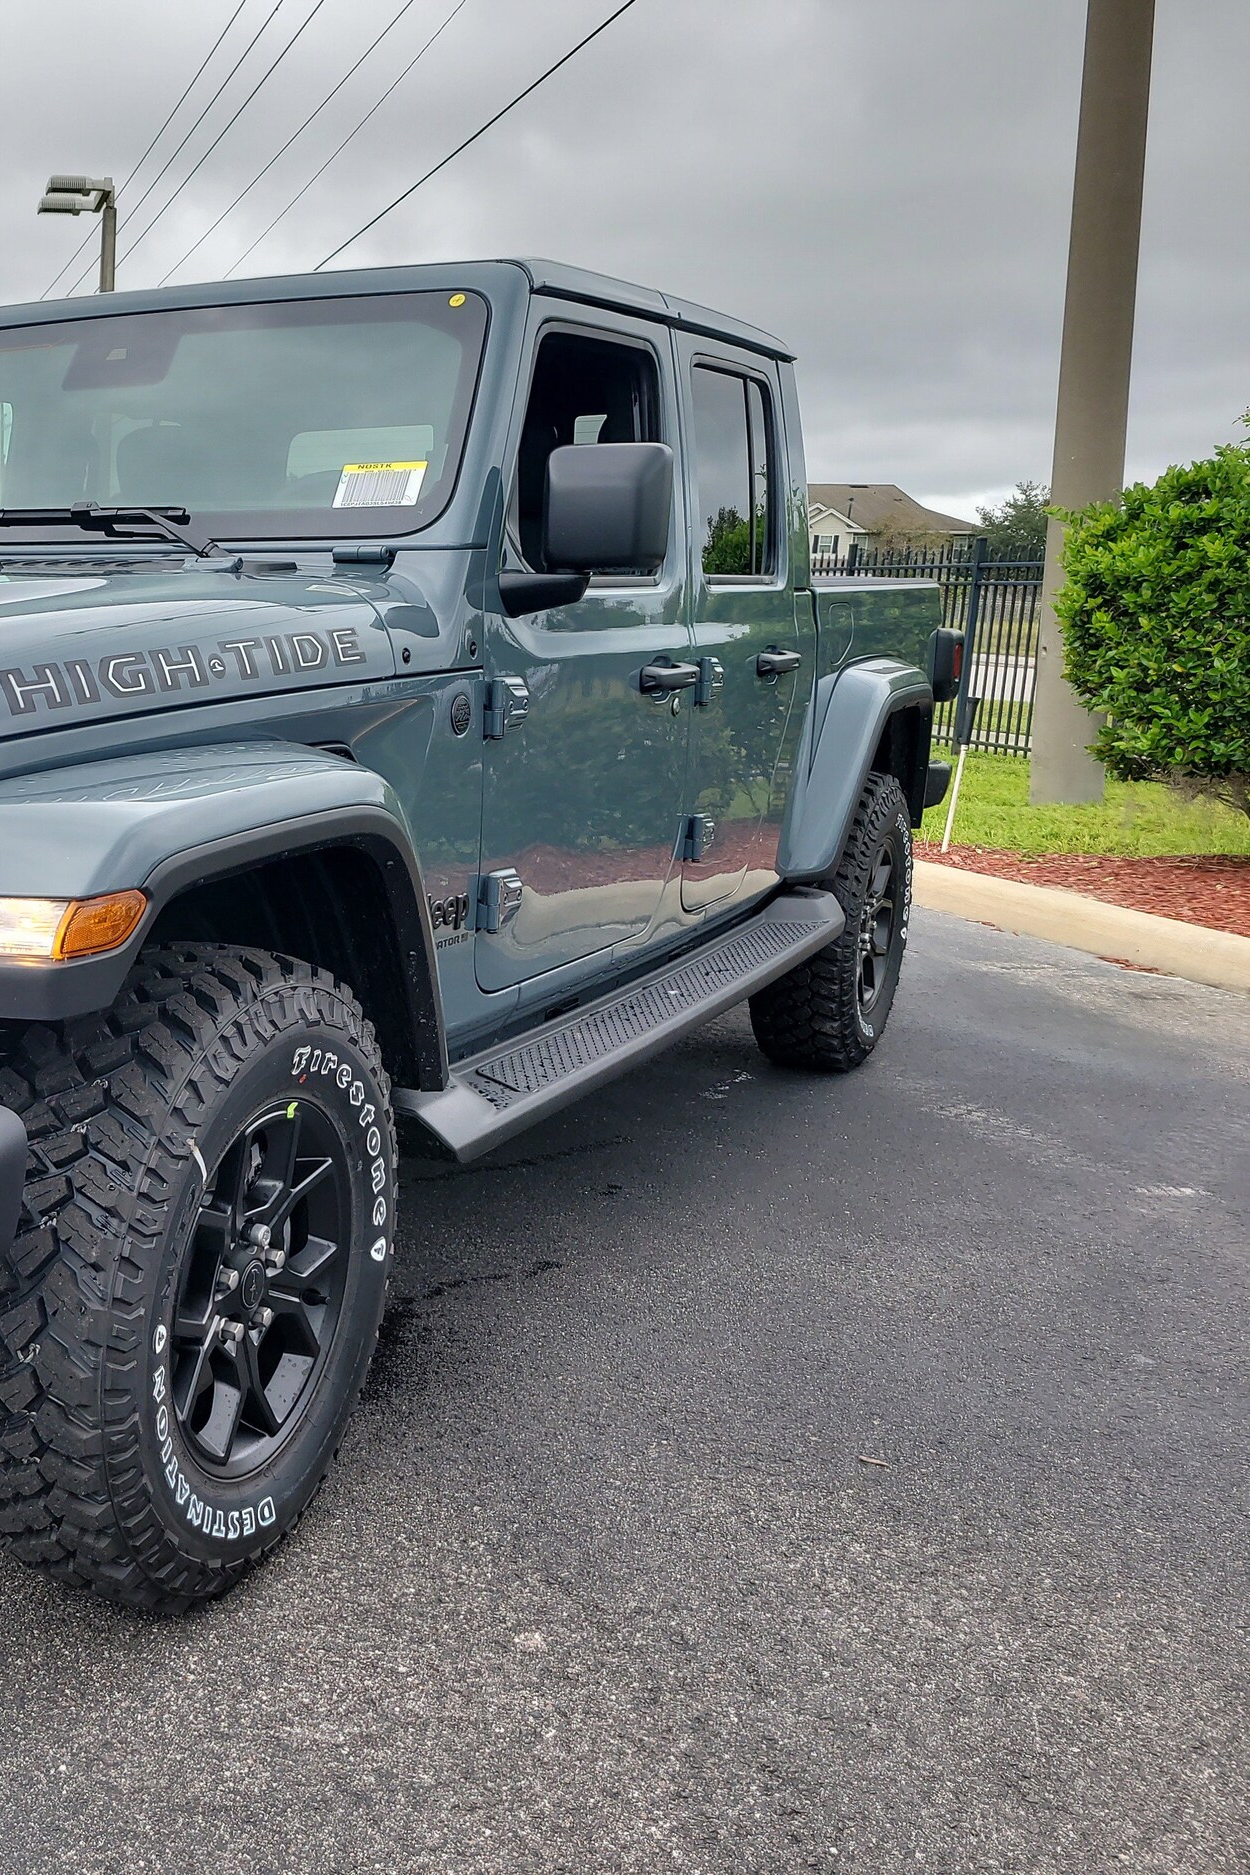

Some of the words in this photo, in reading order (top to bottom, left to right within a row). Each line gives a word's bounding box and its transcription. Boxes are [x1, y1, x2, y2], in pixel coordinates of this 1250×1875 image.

[218, 627, 367, 681] TIDE
[436, 935, 460, 950] ATOR
[291, 1045, 387, 1226] Firestone
[152, 1365, 276, 1539] DESTINATION
